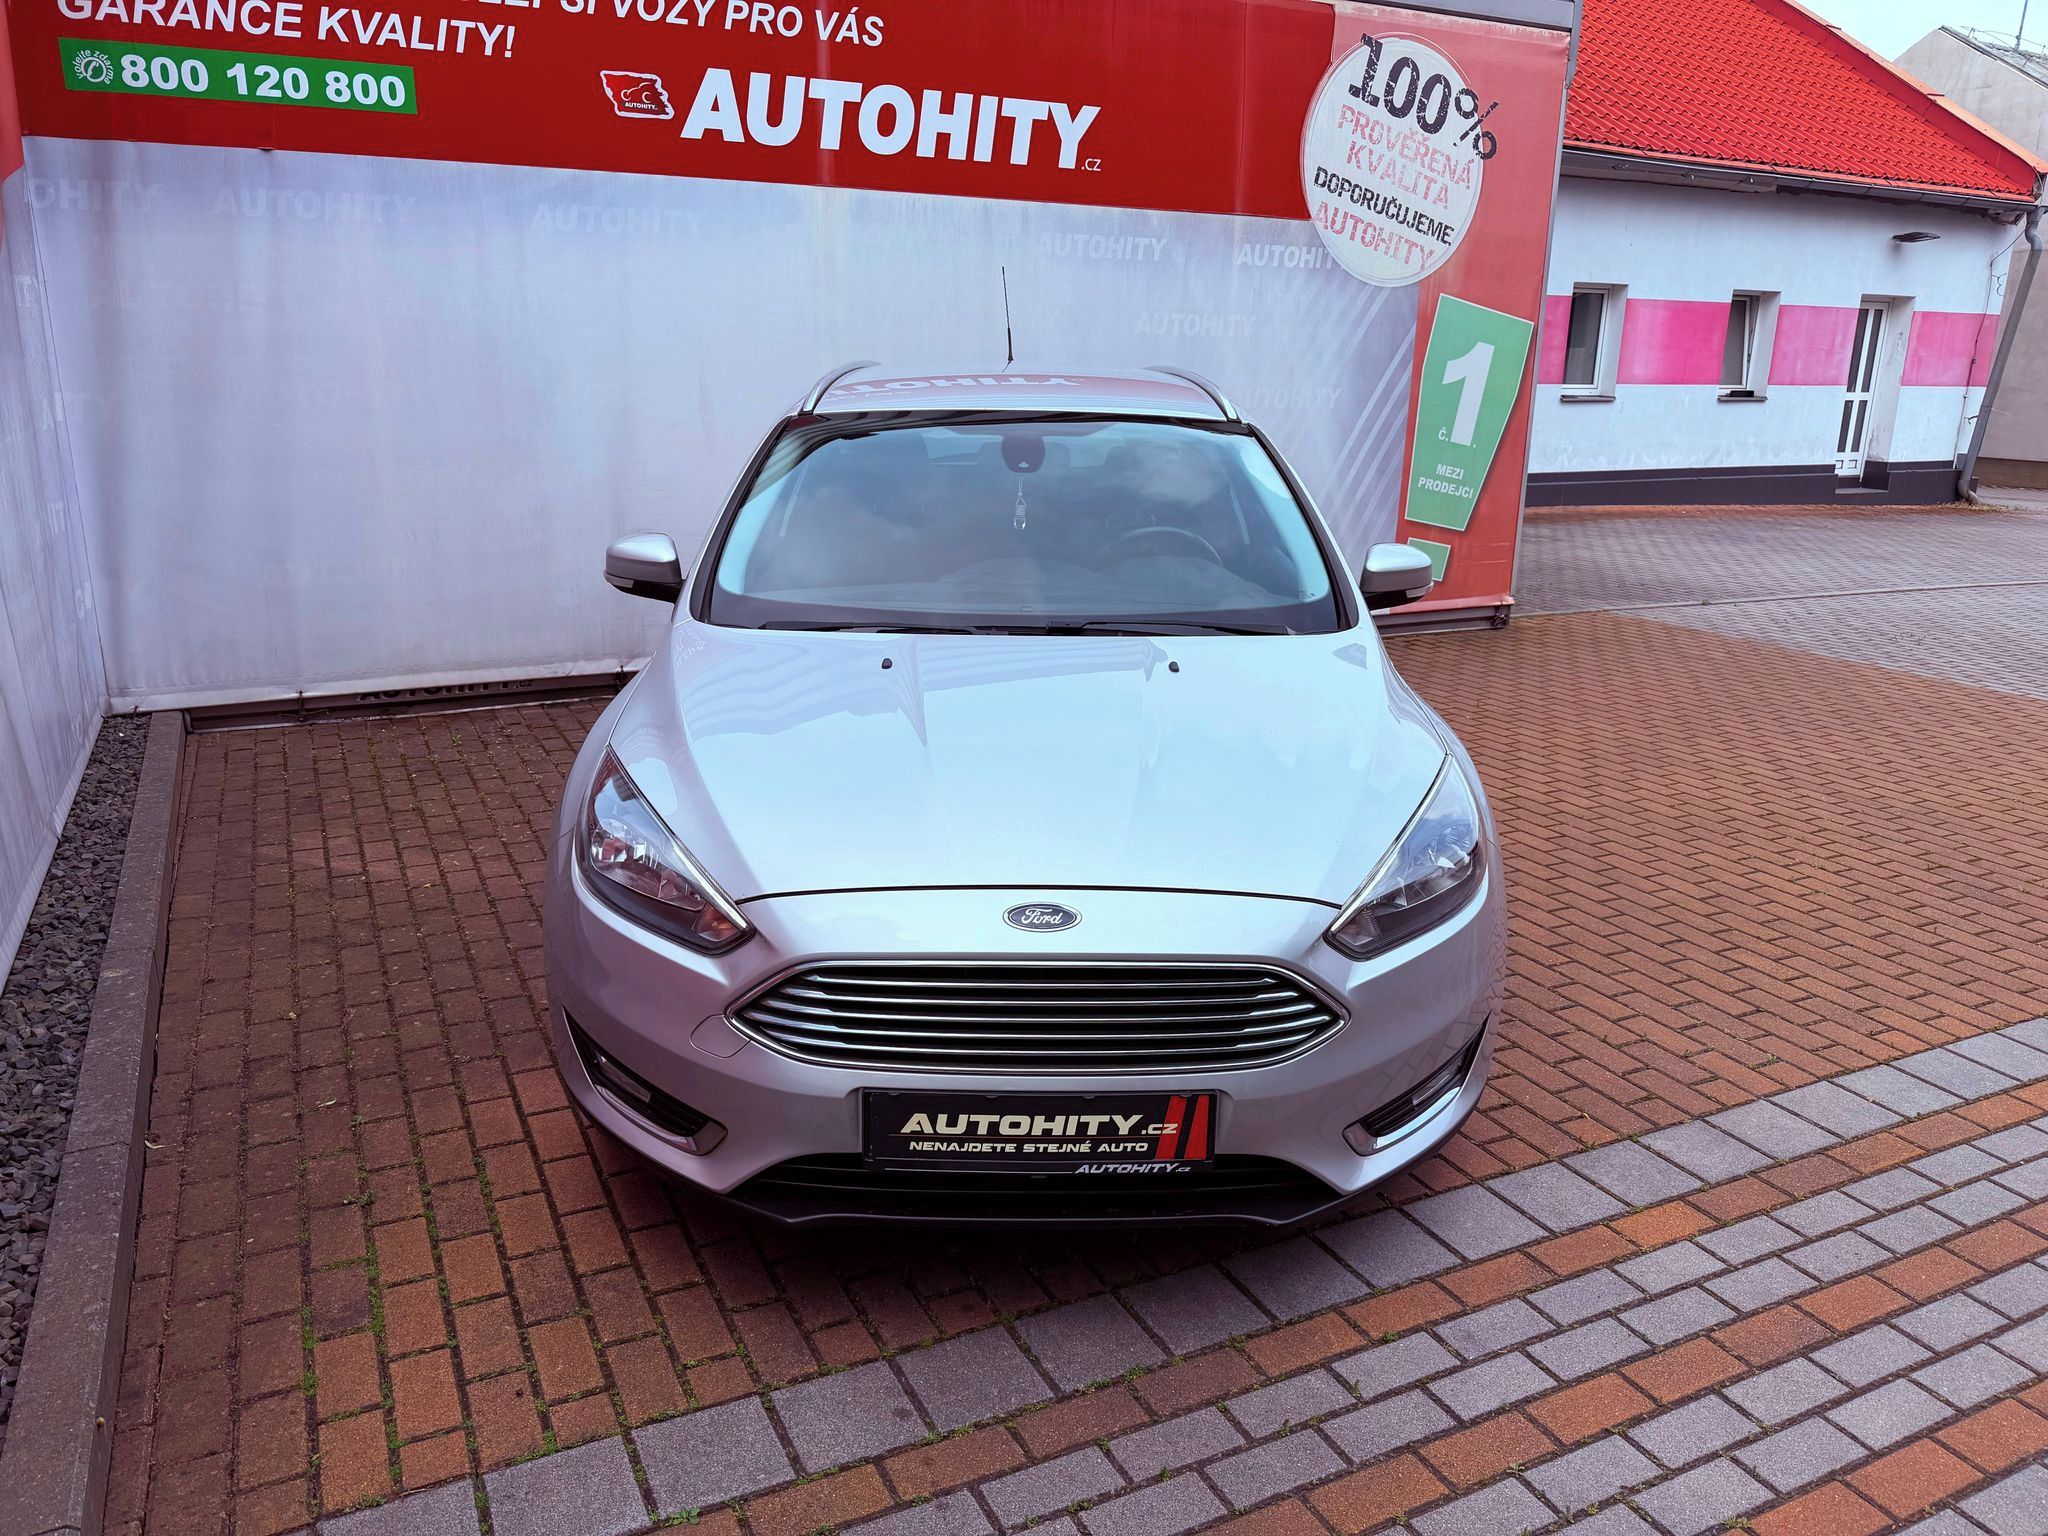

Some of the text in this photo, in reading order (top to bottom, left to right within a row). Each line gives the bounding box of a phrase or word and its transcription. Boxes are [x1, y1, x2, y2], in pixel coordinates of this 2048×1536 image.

[56, 0, 516, 58] GARANCE KVALITY!
[612, 0, 885, 47] VOZY PRO VÁS
[120, 53, 406, 107] 800 120 800
[1348, 33, 1499, 160] 100%
[1337, 104, 1475, 190] PROVĚŘENÁ
[1346, 141, 1450, 210] KVALITA
[1313, 166, 1455, 247] DOPORUČUJEME
[1036, 231, 1167, 261] AUTOHITY
[1236, 243, 1333, 269] AUTOHIT
[1311, 200, 1436, 271] AUTOHITY
[1133, 311, 1257, 336] AUTOHITY
[1417, 477, 1474, 499] PRODEJCI
[1435, 463, 1465, 480] MEZI
[1021, 907, 1063, 924] Ford
[909, 1140, 1149, 1154] NENAJDETE STEJNÉ AUTO
